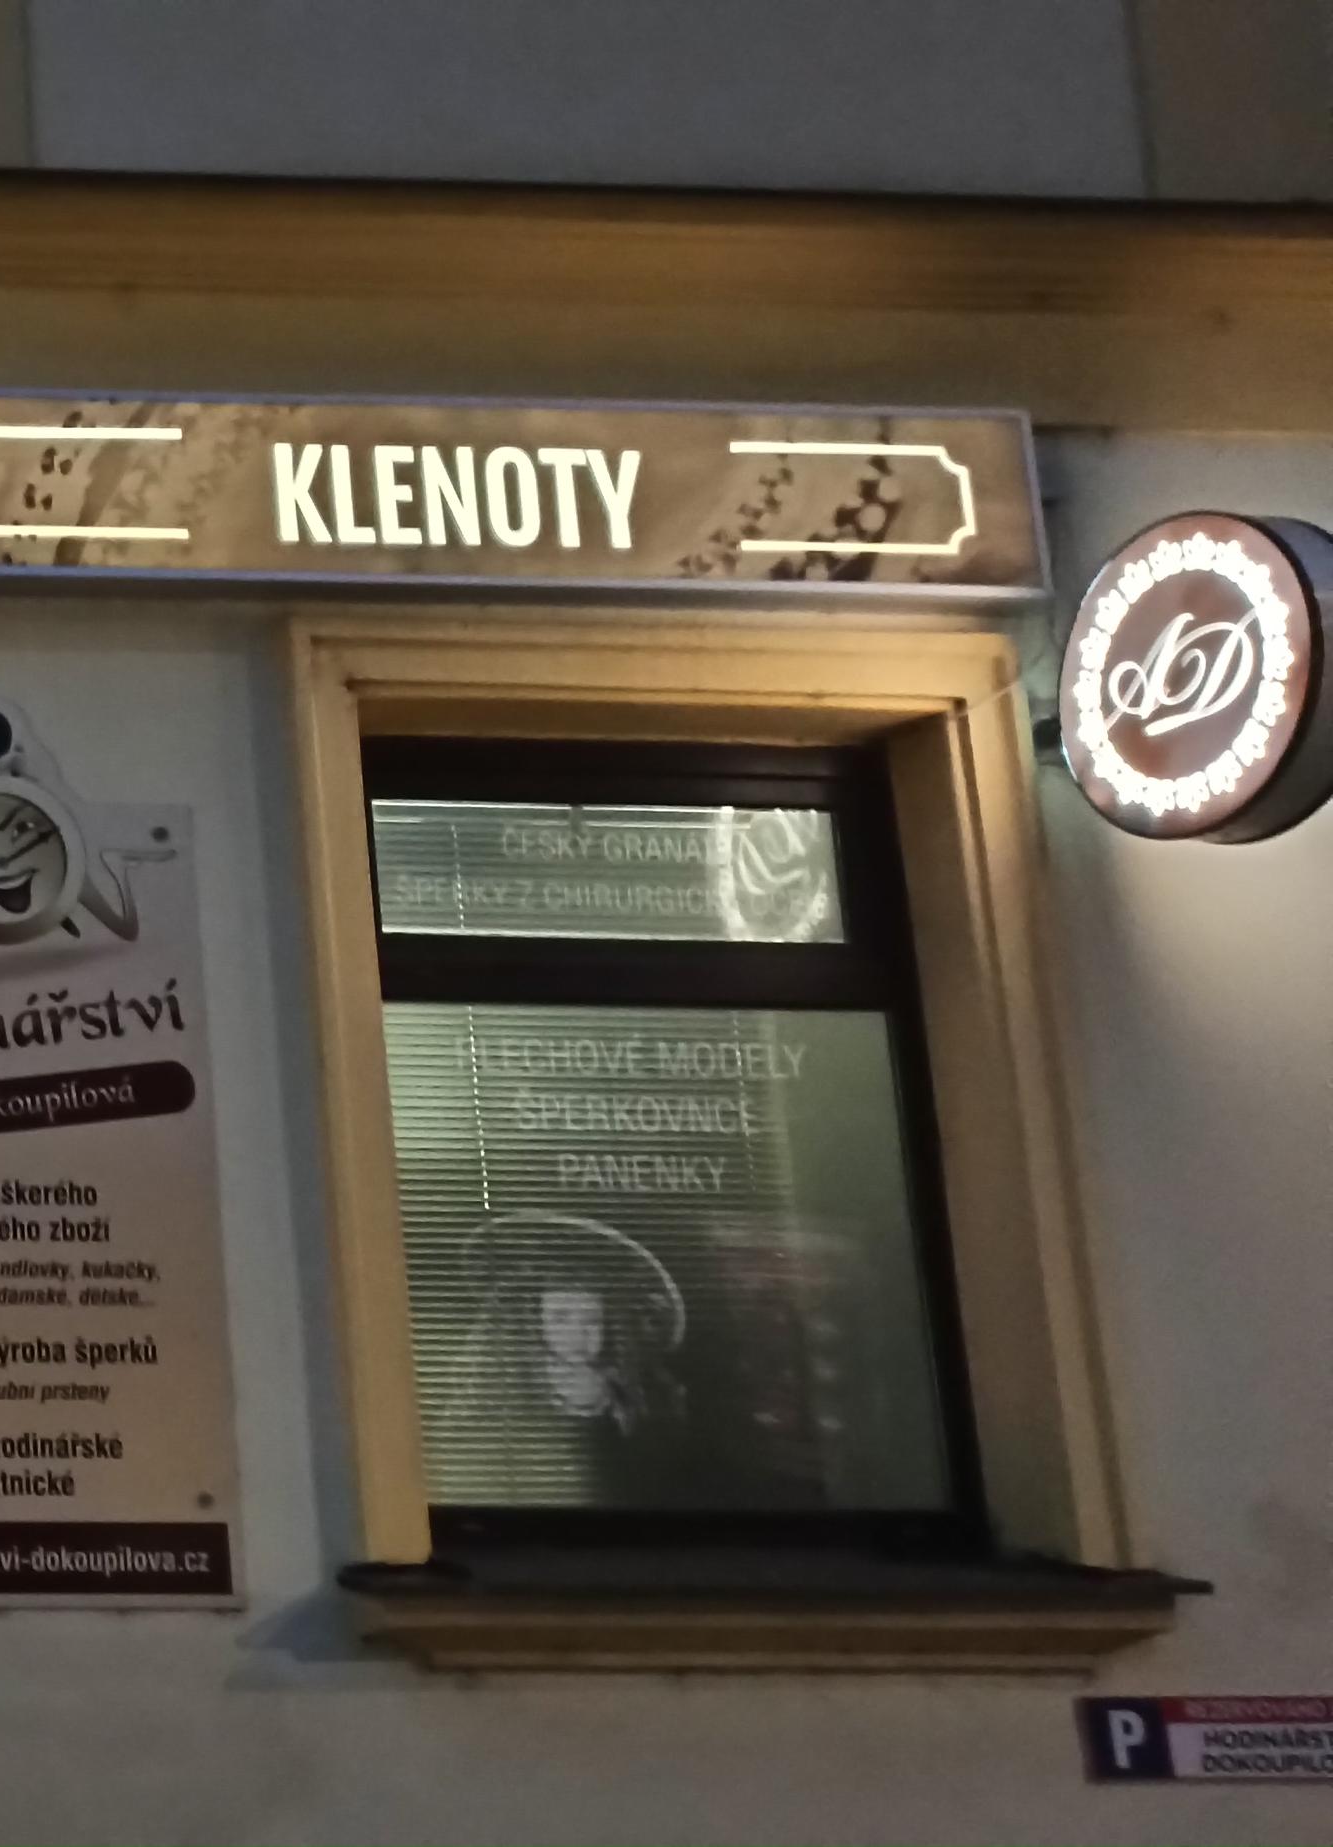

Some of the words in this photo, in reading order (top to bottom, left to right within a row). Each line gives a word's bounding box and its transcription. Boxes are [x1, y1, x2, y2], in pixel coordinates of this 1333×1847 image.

[274, 442, 641, 549] KLENOTY
[1105, 613, 1257, 736] AD
[657, 1041, 807, 1080] MODELY
[556, 1153, 727, 1192] PANENKY
[50, 1215, 110, 1243] zboží
[75, 1334, 158, 1368] šperků
[41, 1382, 110, 1404] prsteny
[1107, 1709, 1145, 1769] P
